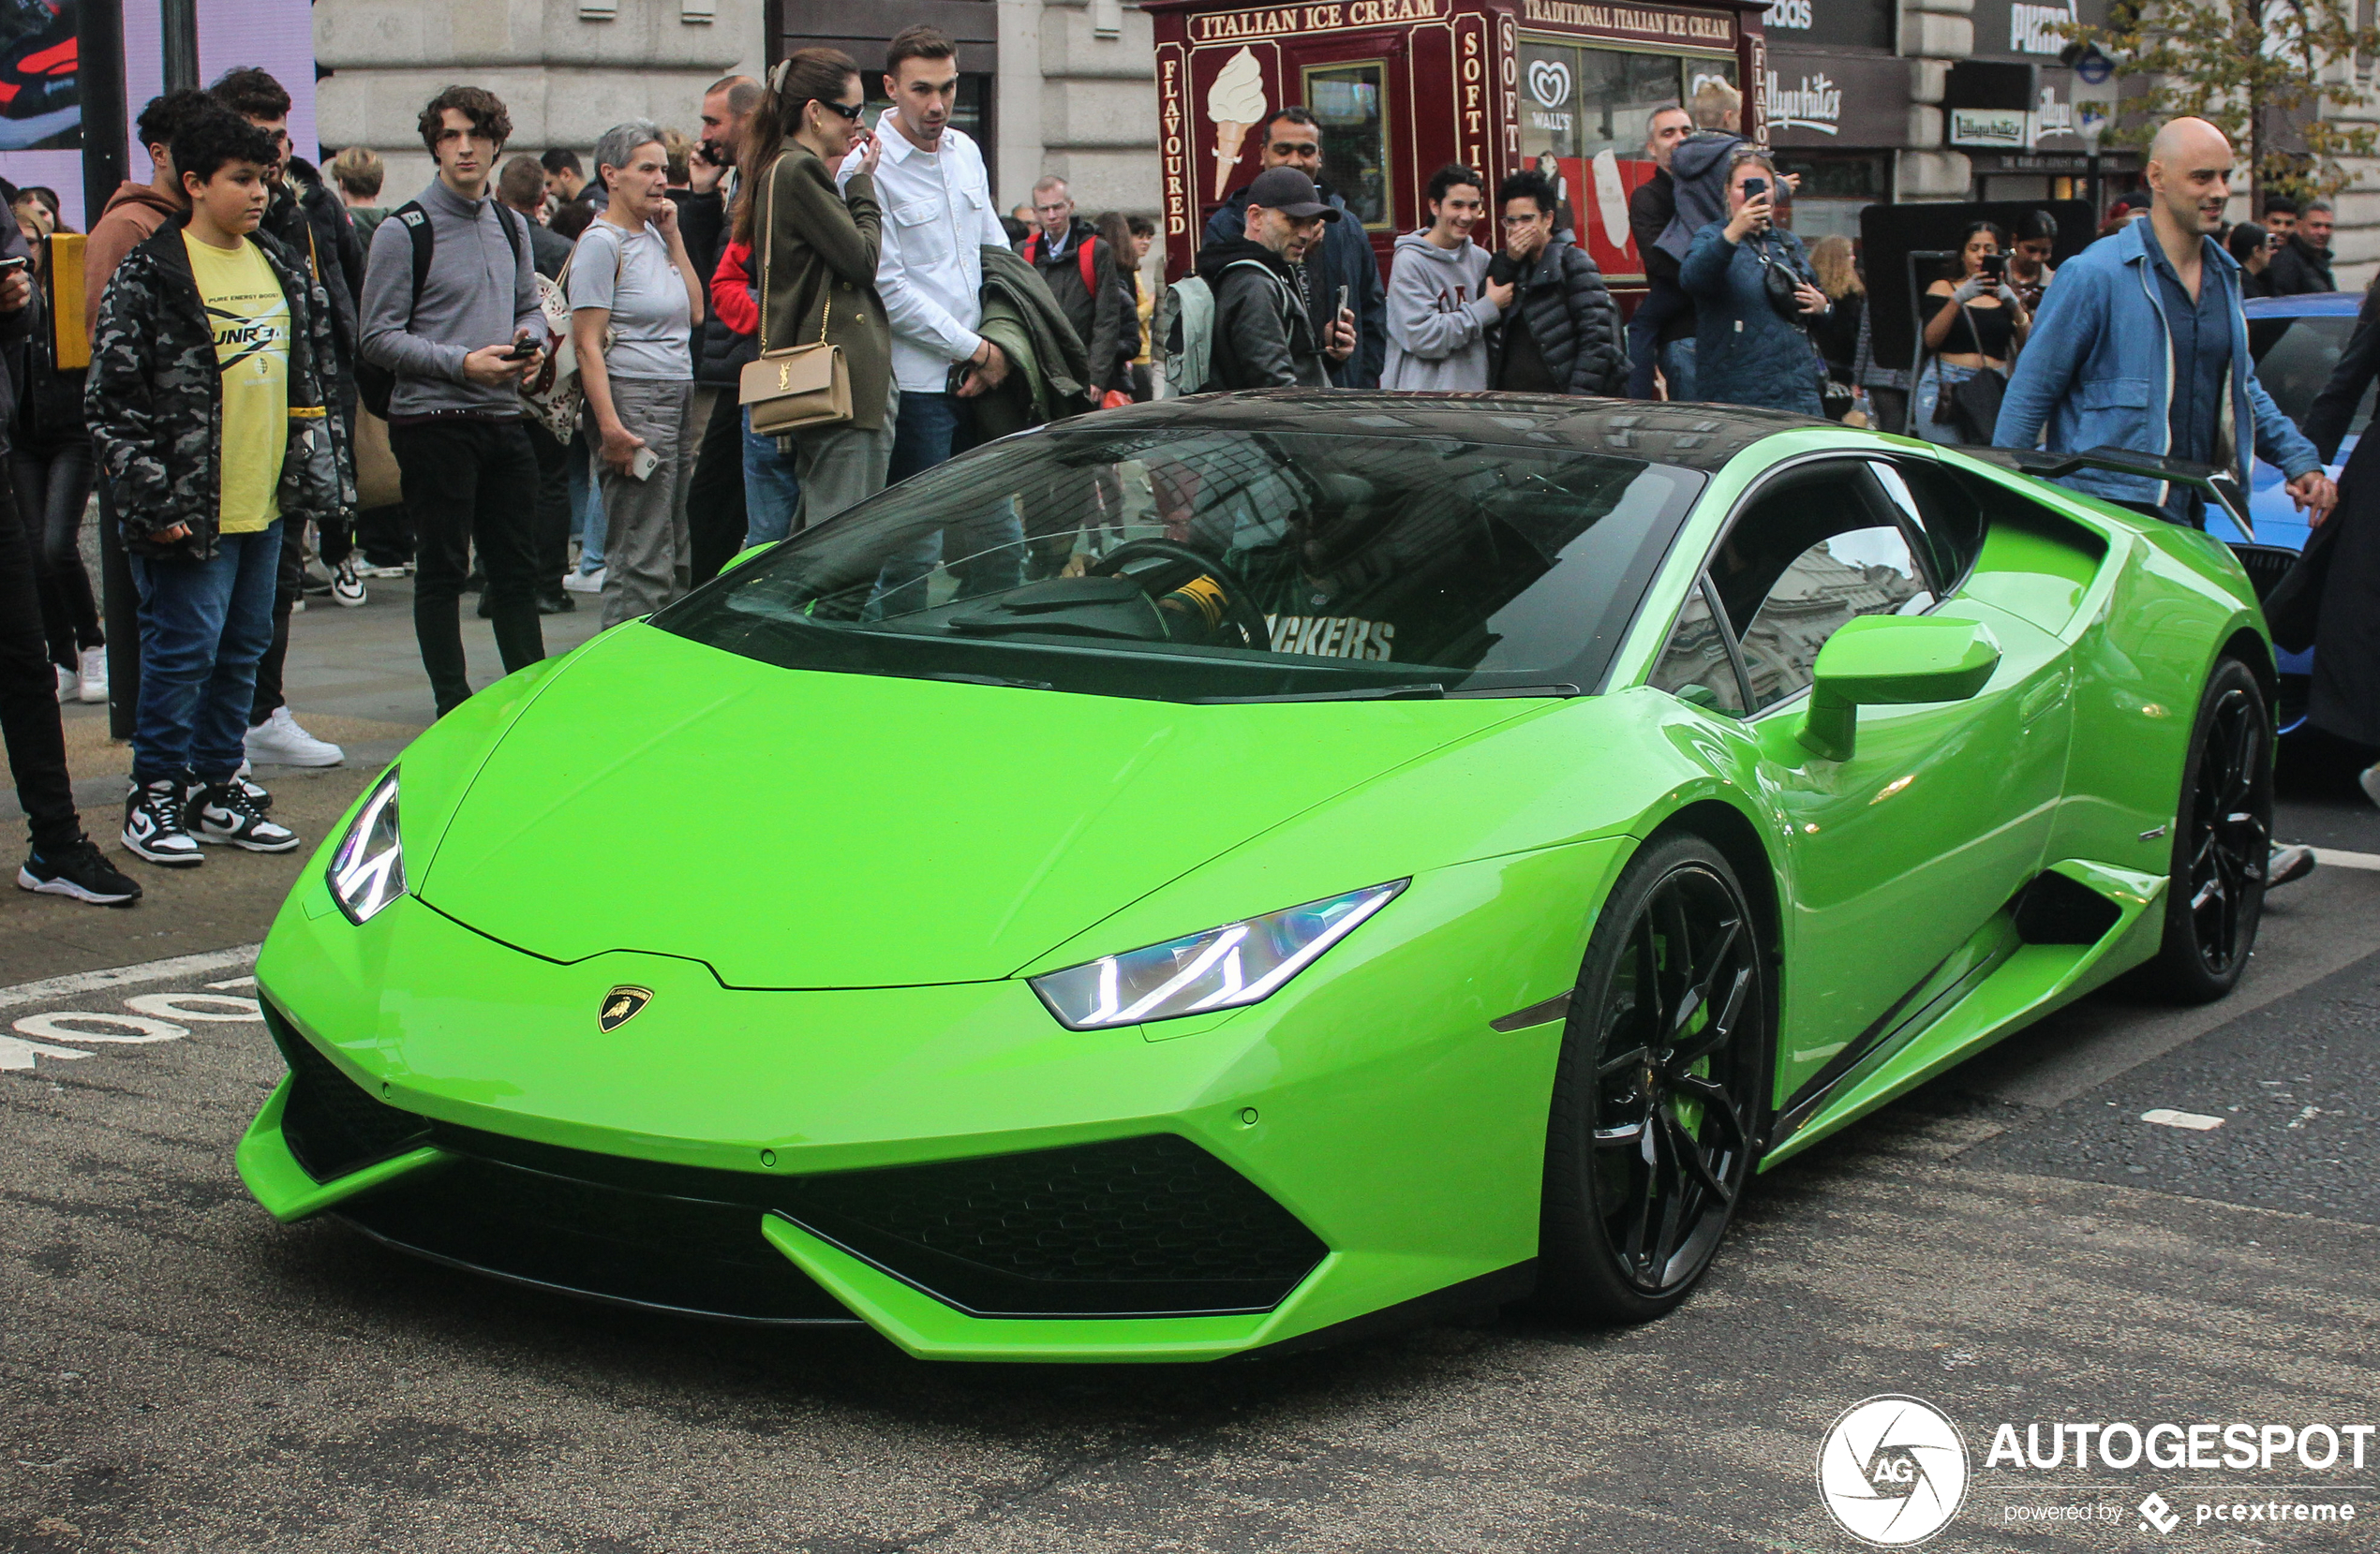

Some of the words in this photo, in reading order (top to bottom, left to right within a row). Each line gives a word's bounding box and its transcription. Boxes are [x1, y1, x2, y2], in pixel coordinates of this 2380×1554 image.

[1201, 16, 1298, 38] ITALIAN
[1304, 10, 1343, 30] ICE
[1349, 0, 1437, 25] CREAM
[1523, 0, 1612, 28] TRADITIONAL
[1614, 7, 1665, 33] ITALIAN
[1667, 14, 1687, 36] ICE
[1688, 16, 1731, 39] CREAM
[1464, 32, 1481, 133] SOFT
[1502, 22, 1519, 152] SOFT
[1163, 60, 1185, 235] FLAVOURED
[1532, 111, 1572, 130] WALL'S
